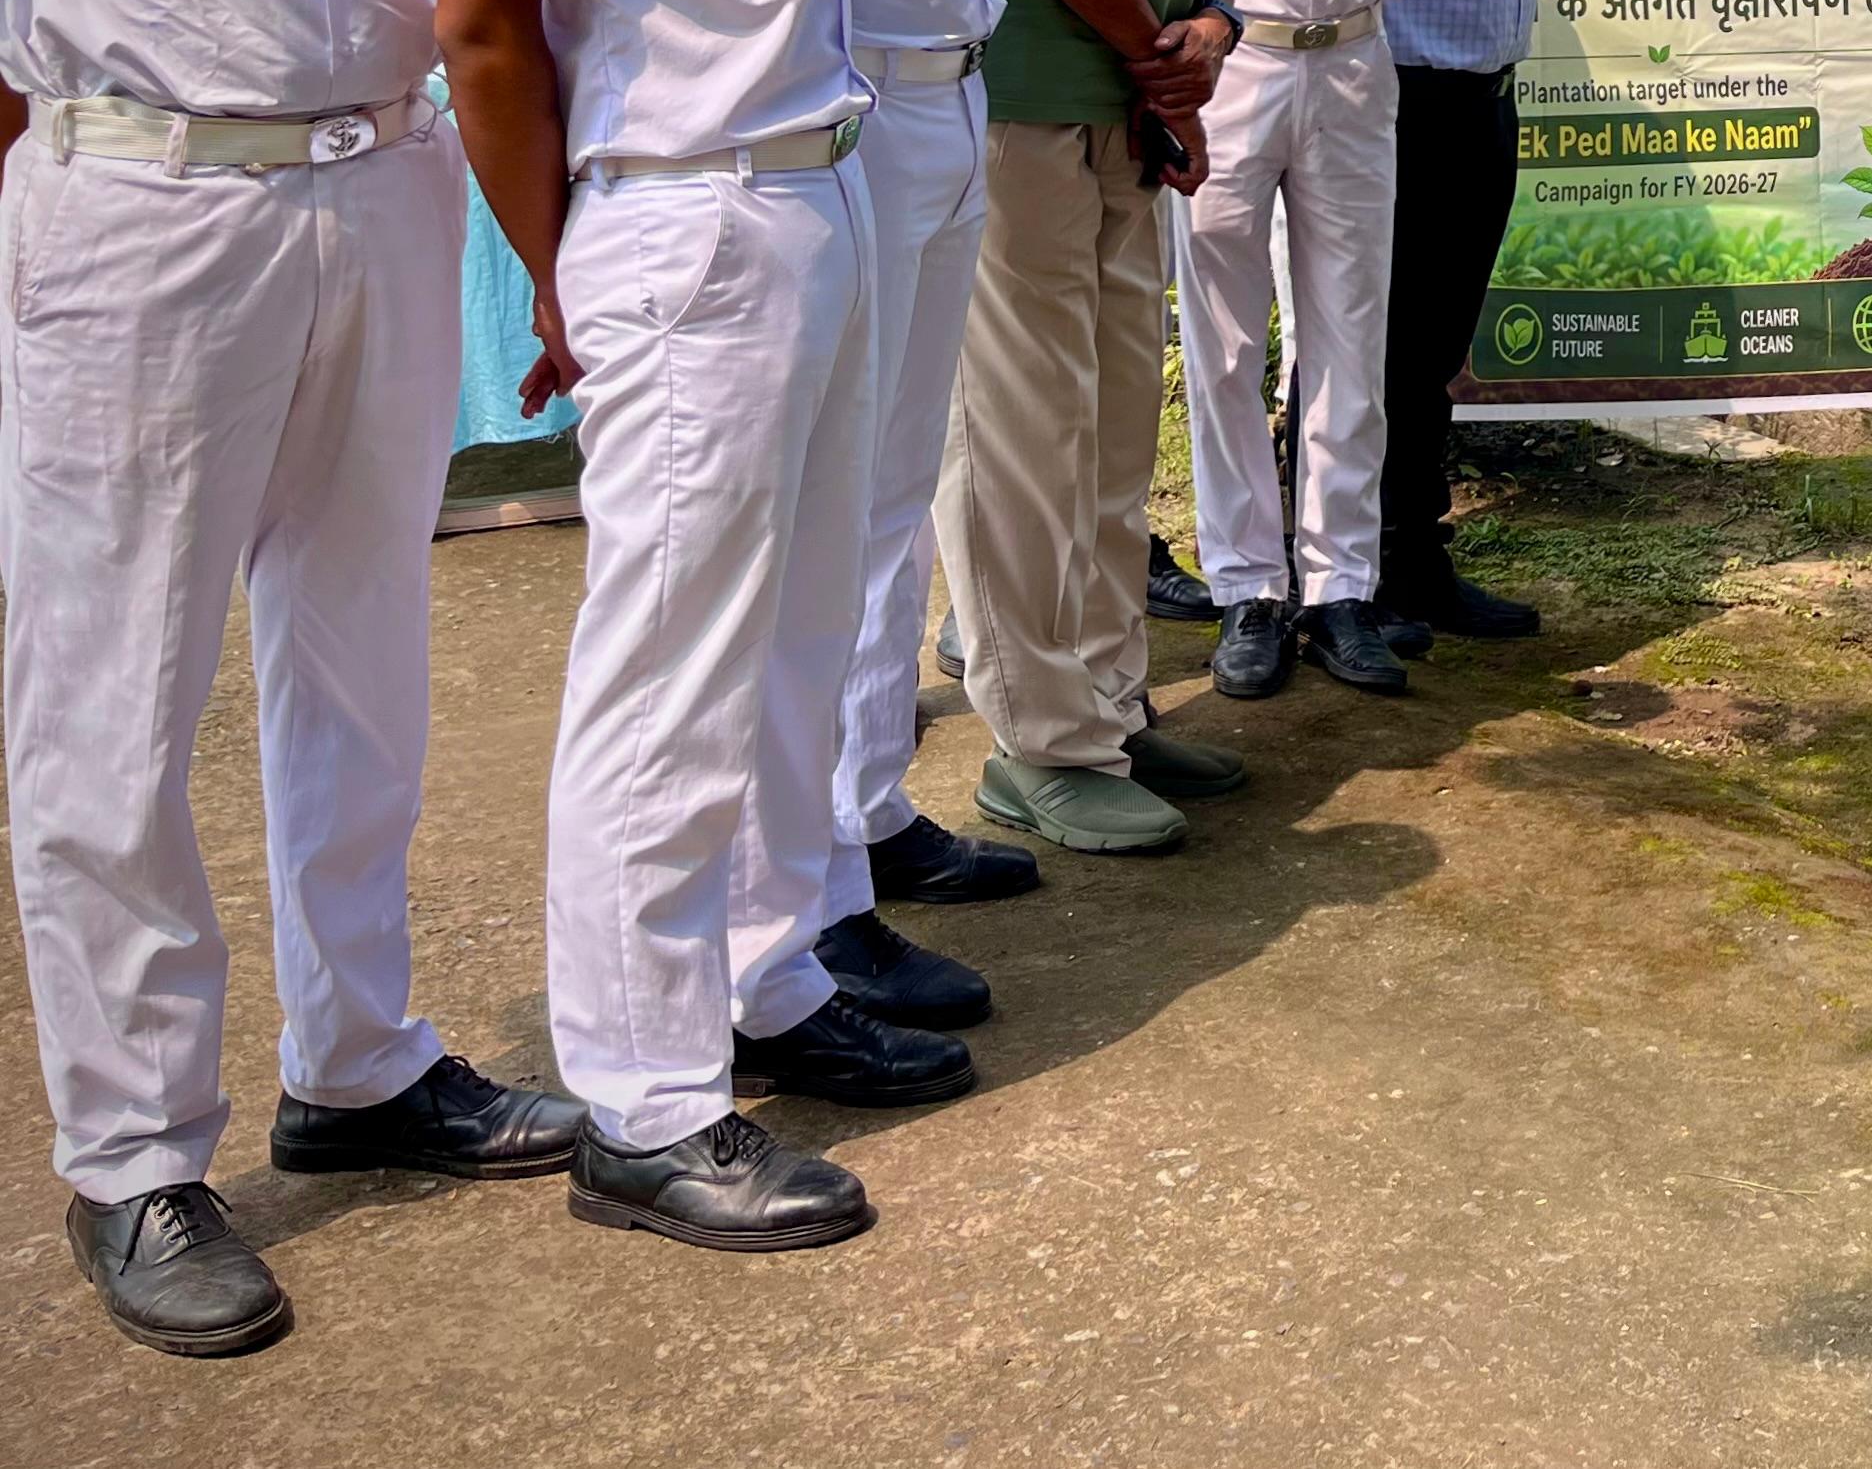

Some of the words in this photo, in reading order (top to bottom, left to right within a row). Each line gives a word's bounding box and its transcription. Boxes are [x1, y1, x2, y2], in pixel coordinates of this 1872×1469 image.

[1518, 80, 1621, 104] Plantation
[1627, 78, 1687, 106] target
[1693, 76, 1750, 98] under
[1757, 74, 1788, 96] the
[1517, 124, 1550, 159] Ek
[1559, 123, 1612, 158] Ped
[1622, 121, 1678, 155] Maa
[1686, 119, 1717, 153] ke
[1535, 178, 1633, 206] Campaign
[1640, 176, 1668, 198] for
[1674, 175, 1697, 196] FY
[1703, 172, 1778, 195] 2026-27
[1551, 313, 1640, 332] SUSTAINABLE
[1740, 308, 1799, 329] CLEANER
[1551, 339, 1603, 358] FUTURE
[1740, 335, 1794, 355] OCEANS
